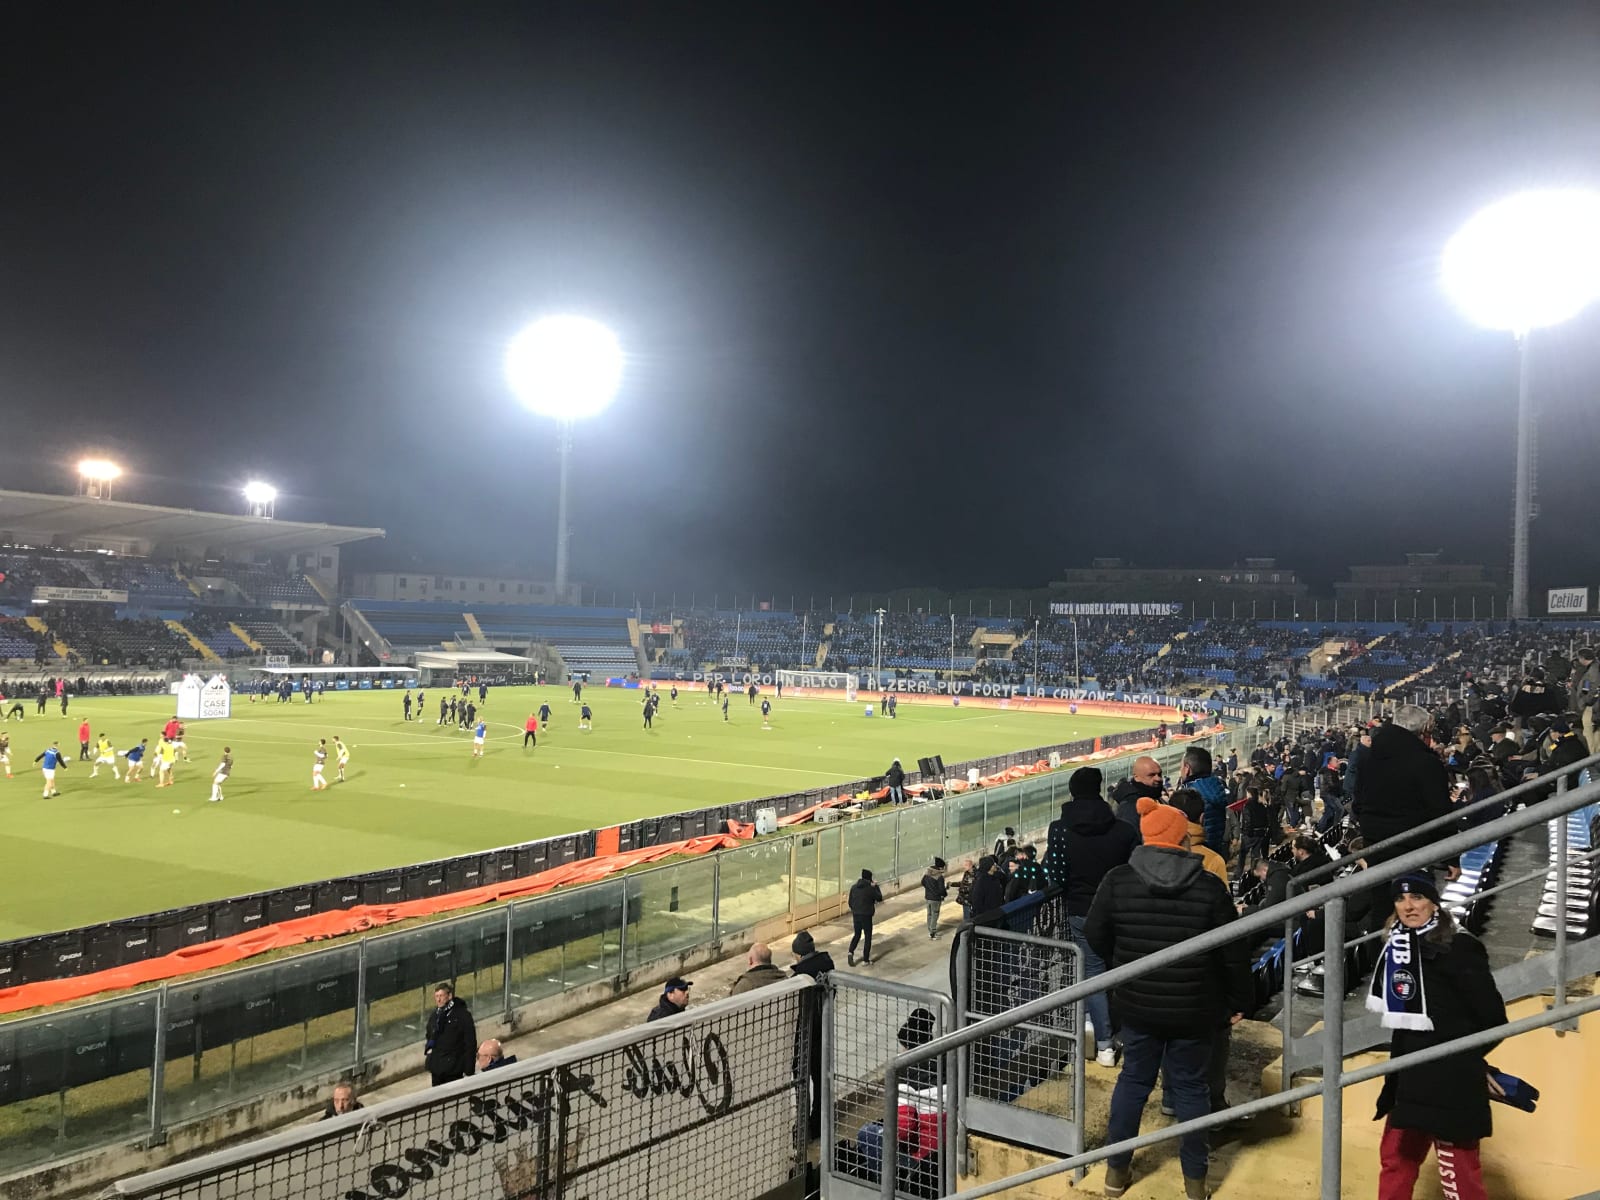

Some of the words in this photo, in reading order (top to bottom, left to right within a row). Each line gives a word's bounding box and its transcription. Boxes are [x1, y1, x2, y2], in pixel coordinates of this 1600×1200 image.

[1550, 592, 1584, 609] Cetilar
[1050, 603, 1073, 615] FORZA
[1075, 603, 1103, 615] ANDREA
[1106, 603, 1128, 615] LOTTA
[1131, 603, 1140, 615] DA
[1142, 603, 1170, 616] ULTRAS
[693, 673, 724, 684] PER
[731, 673, 772, 685] LORO
[801, 676, 838, 688] ALTO
[972, 683, 1020, 698] FORTE
[1026, 685, 1045, 698] LA
[1053, 688, 1115, 701] CANZONE
[1124, 692, 1160, 706] DEGLI
[203, 699, 226, 708] CASE
[202, 708, 226, 716] SOGNI
[1391, 929, 1412, 965] UB
